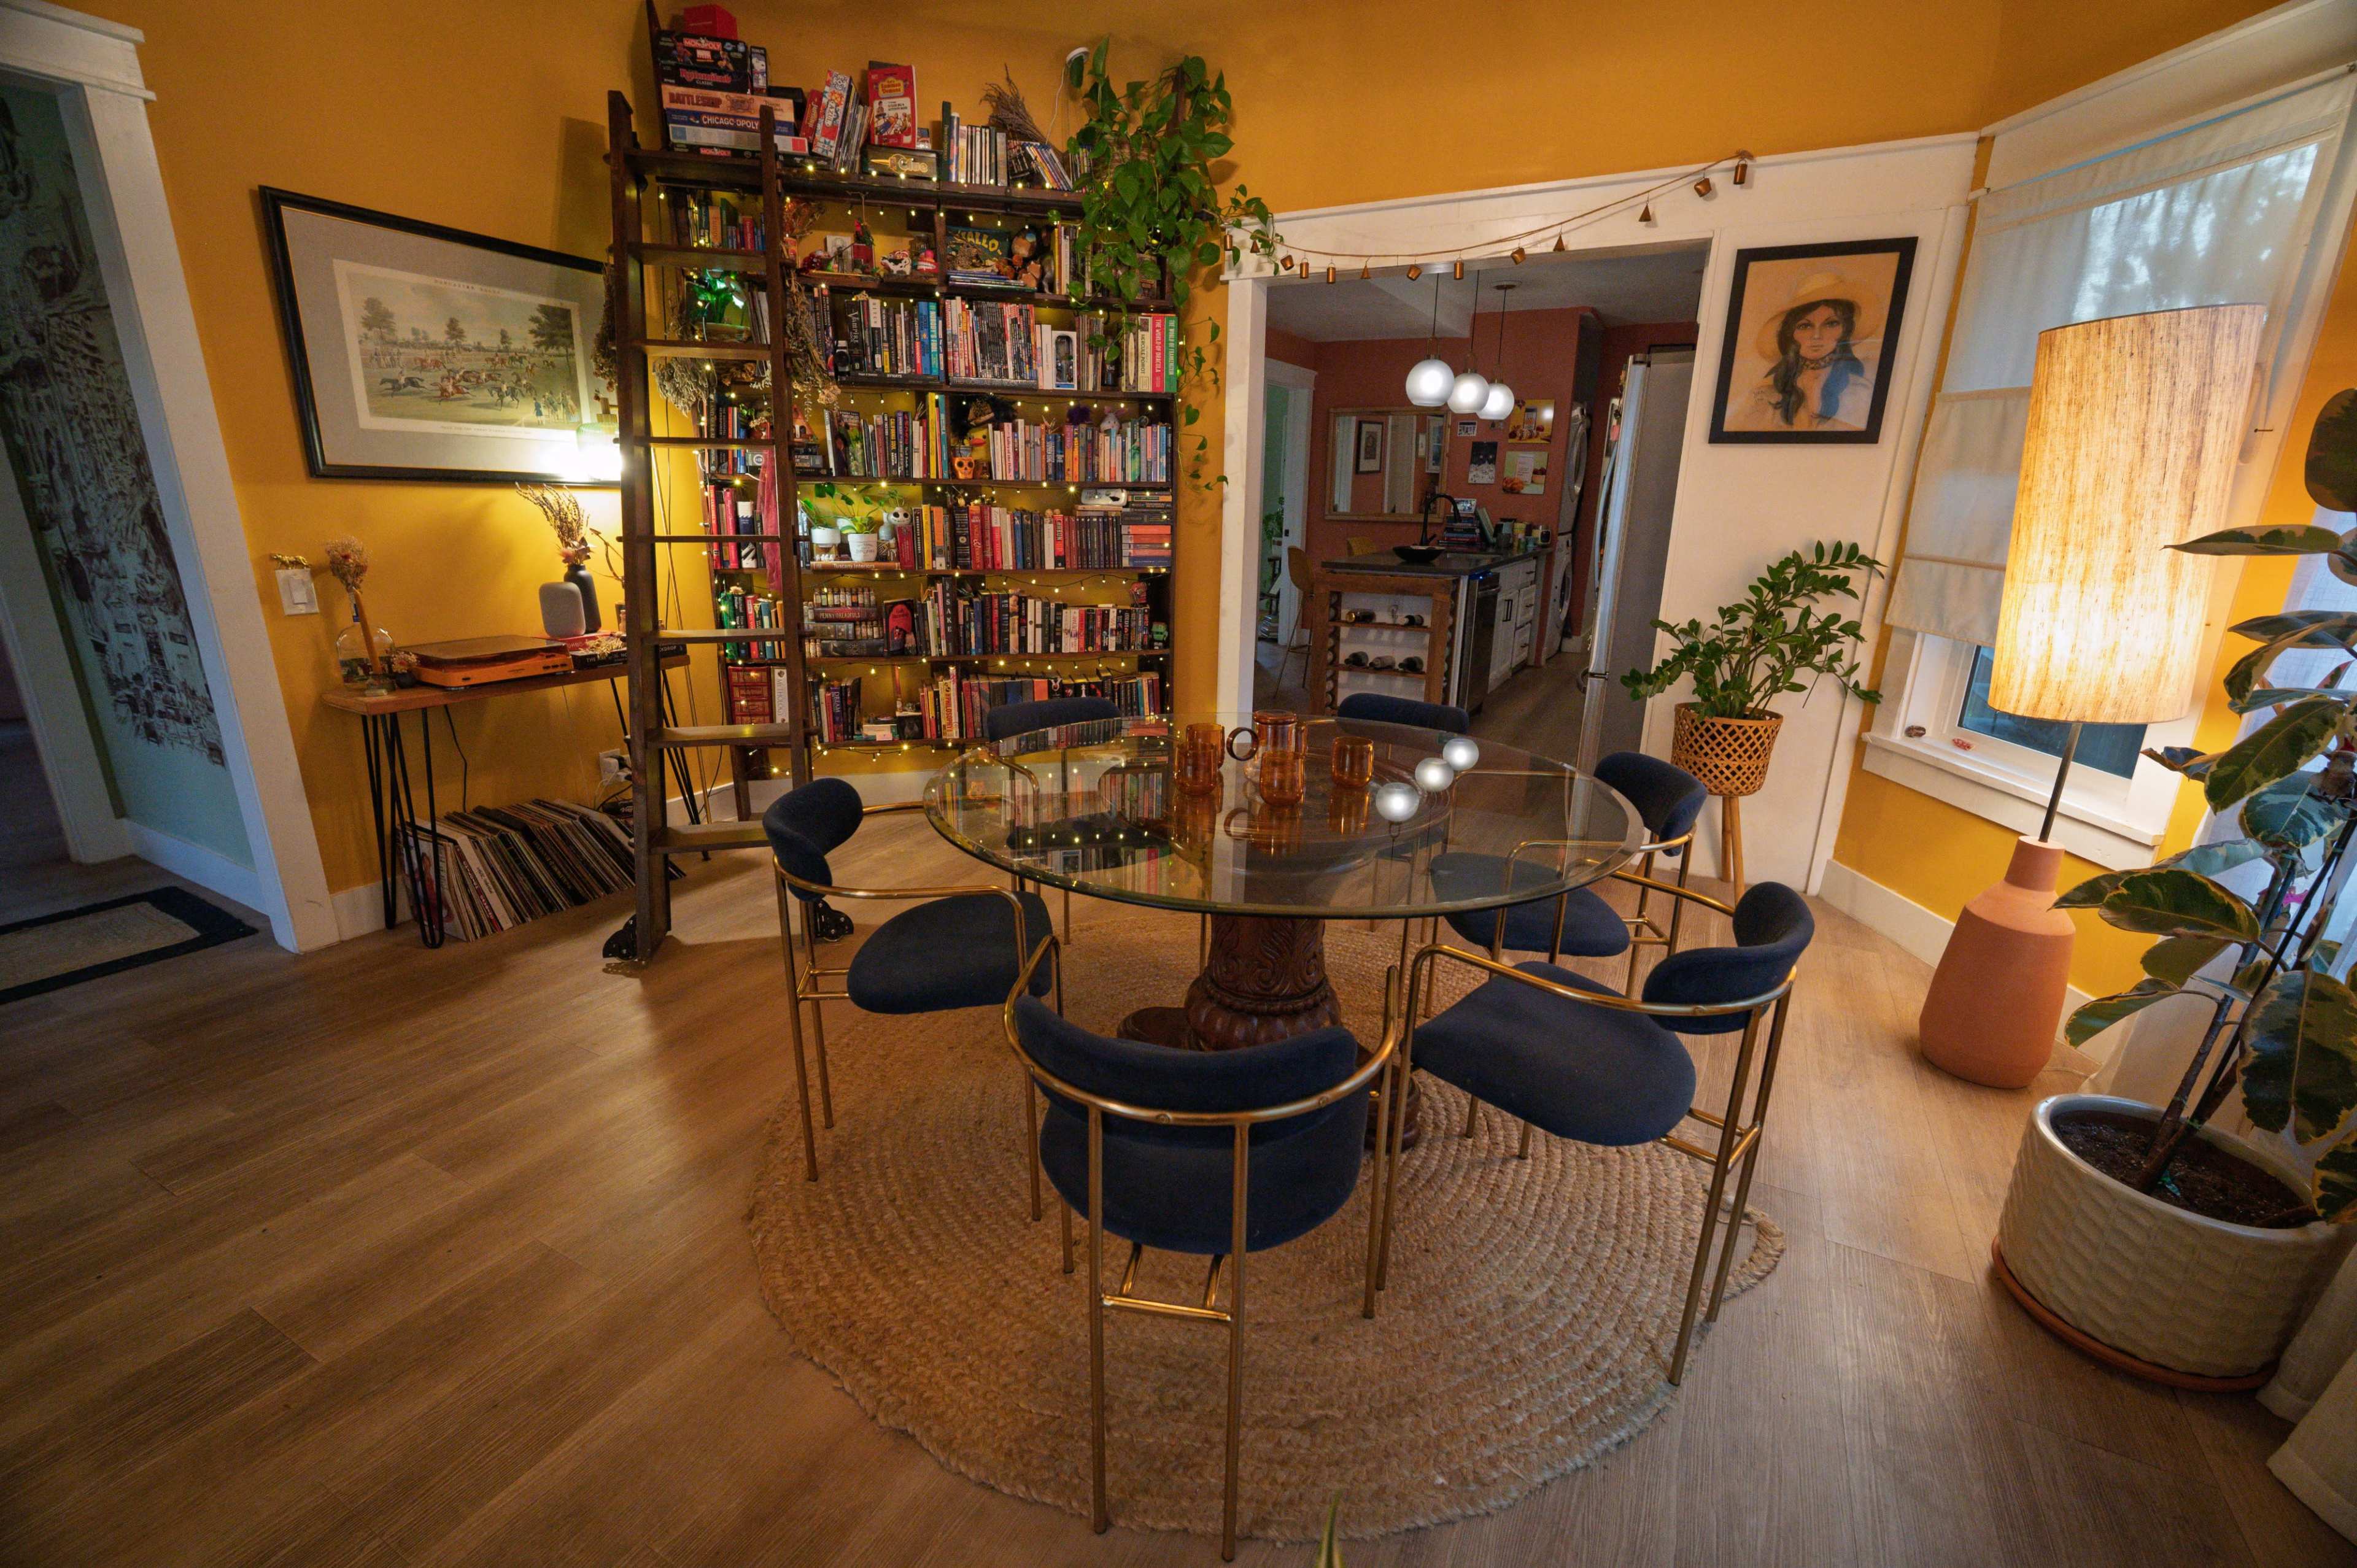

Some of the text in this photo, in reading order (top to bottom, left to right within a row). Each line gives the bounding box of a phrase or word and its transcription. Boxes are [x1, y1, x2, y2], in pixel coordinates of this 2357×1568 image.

[668, 91, 722, 109] BATTLESHIP
[826, 104, 835, 126] AZUL
[898, 158, 929, 174] Clue
